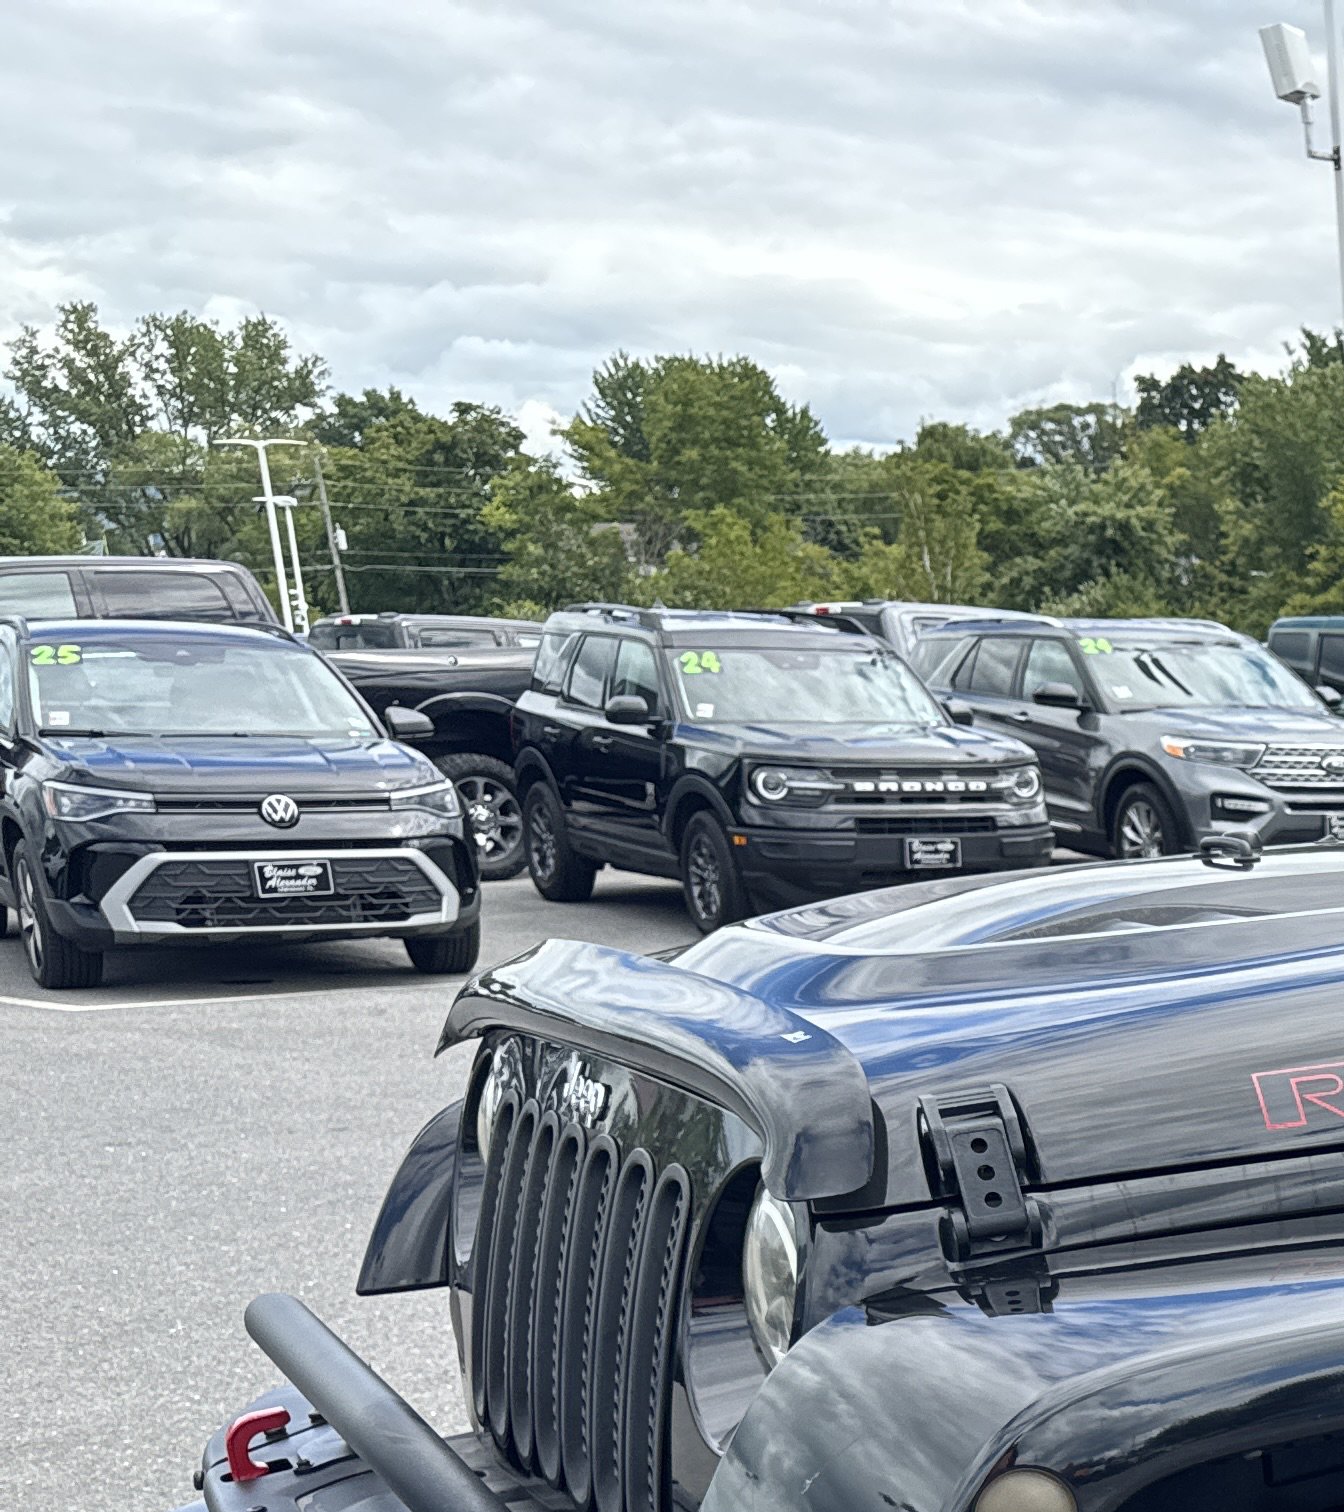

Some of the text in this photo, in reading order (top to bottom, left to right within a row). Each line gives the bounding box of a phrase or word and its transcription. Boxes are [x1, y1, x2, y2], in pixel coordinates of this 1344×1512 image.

[30, 645, 81, 665] 25
[680, 650, 720, 673] 24
[853, 781, 987, 792] BRONCO
